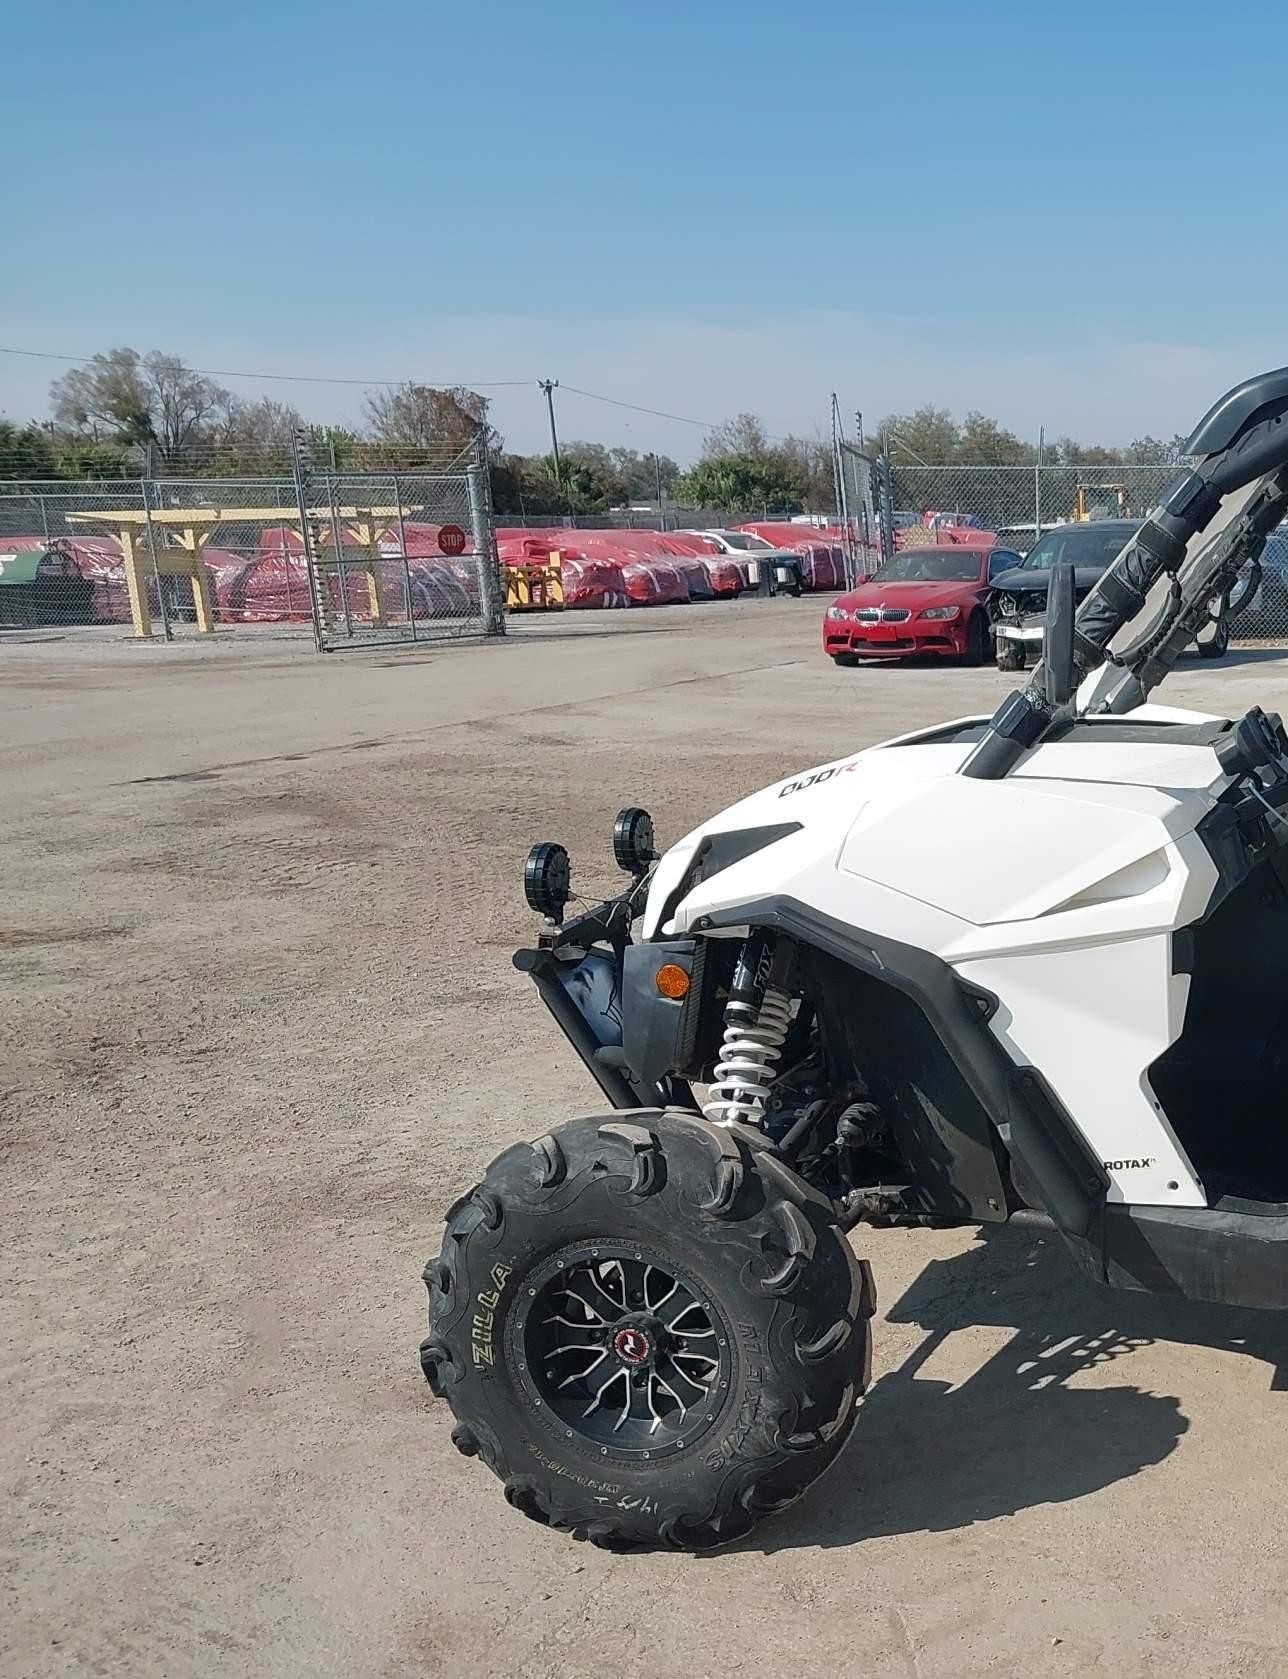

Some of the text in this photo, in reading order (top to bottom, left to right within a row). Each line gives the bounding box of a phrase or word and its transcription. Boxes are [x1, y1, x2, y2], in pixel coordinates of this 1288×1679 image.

[441, 534, 463, 547] STOP
[753, 943, 776, 994] FOX
[1103, 1158, 1151, 1171] ROTAX
